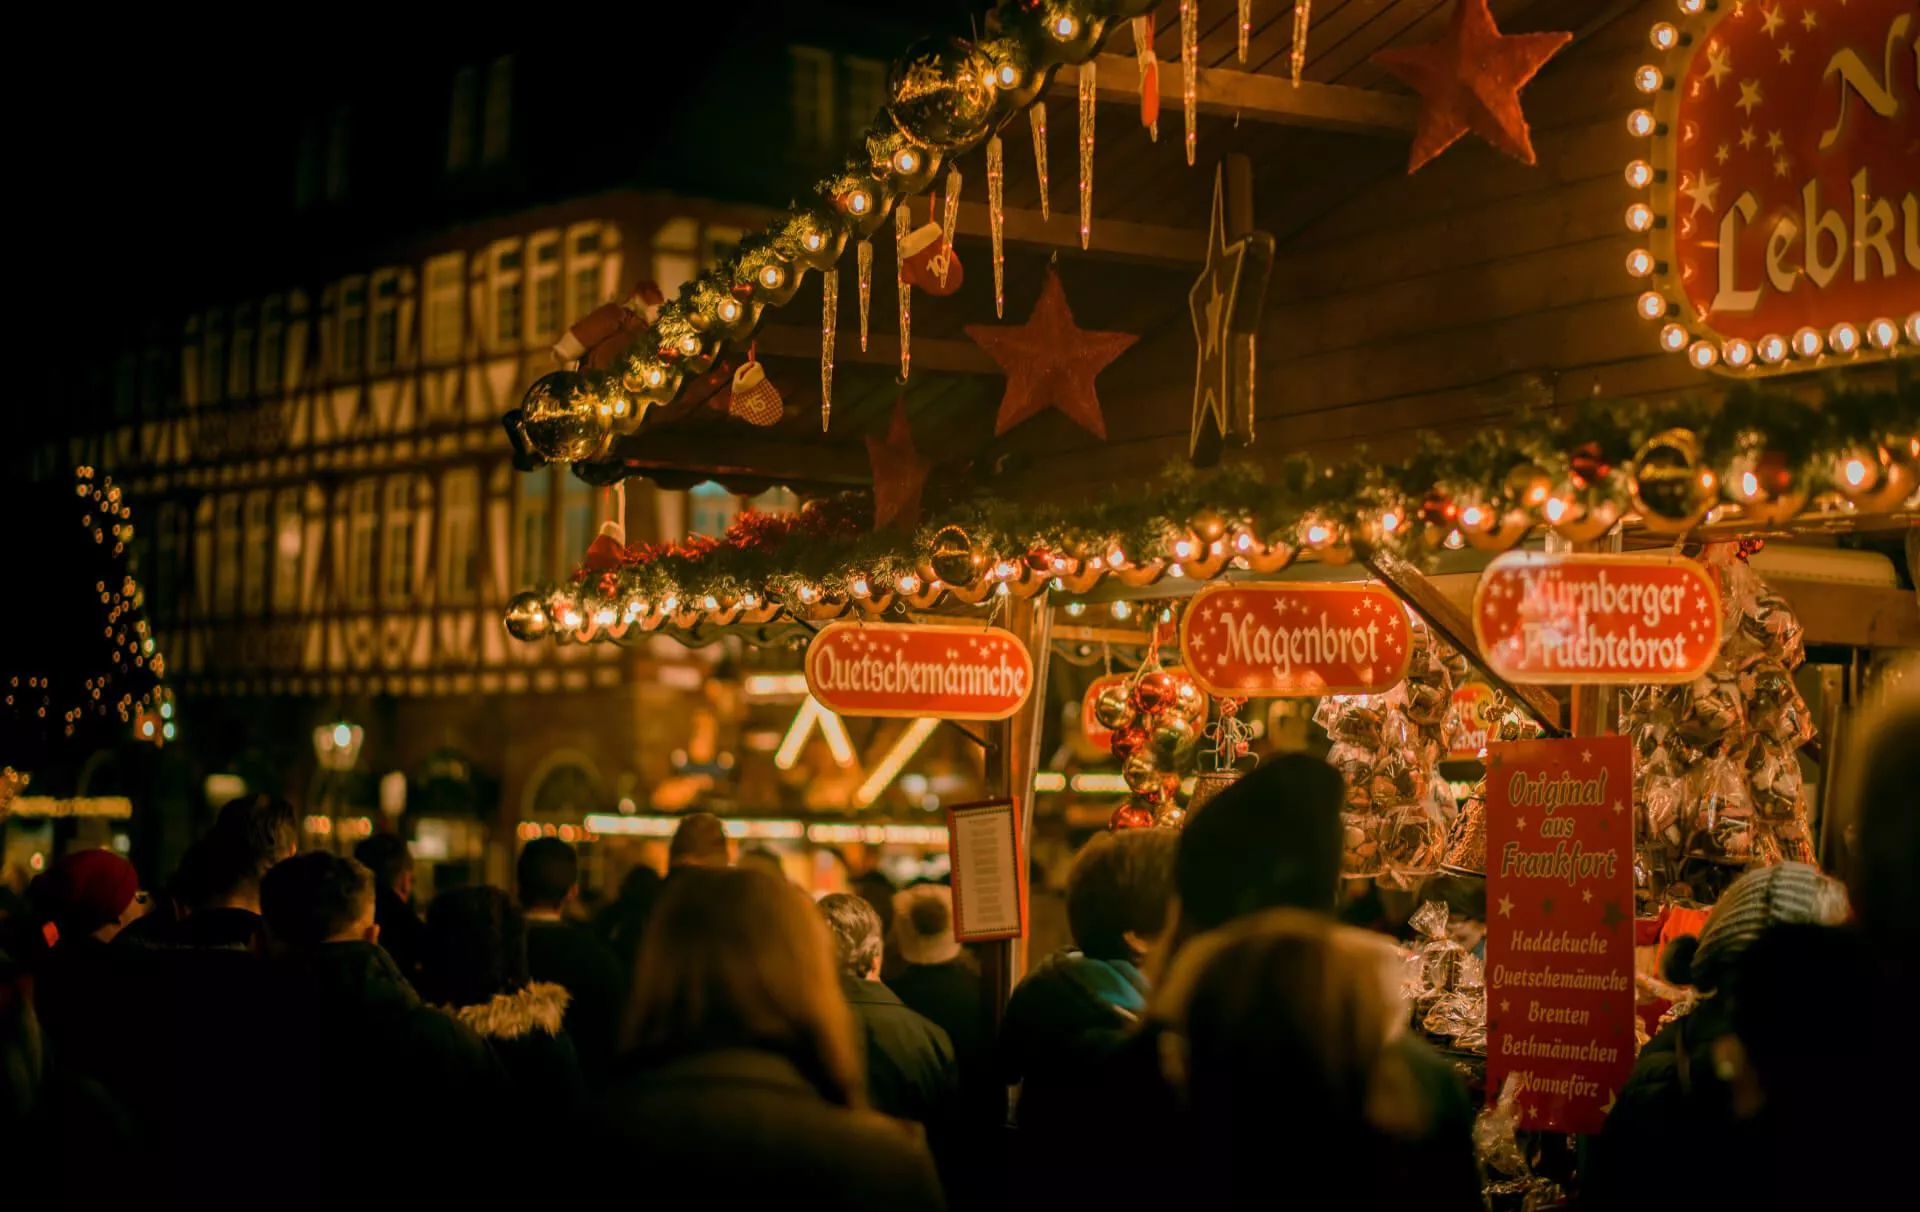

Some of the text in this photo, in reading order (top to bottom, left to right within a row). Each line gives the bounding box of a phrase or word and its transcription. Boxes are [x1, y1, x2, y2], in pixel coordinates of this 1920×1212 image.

[1818, 14, 1920, 150] N
[1517, 568, 1686, 627] Nürnberger
[1216, 611, 1379, 680] Magenbrot
[815, 645, 1025, 697] Quetschemännche
[1508, 766, 1608, 815] Original
[1540, 816, 1576, 838] aus
[1501, 840, 1618, 887] Frankfort
[1510, 929, 1608, 954] Haddekuche
[1492, 964, 1628, 991] Quetschemännche
[1528, 1000, 1590, 1025] Brenten
[1501, 1033, 1618, 1063] Bethmännchen
[1520, 1070, 1600, 1100] Nonneförz
